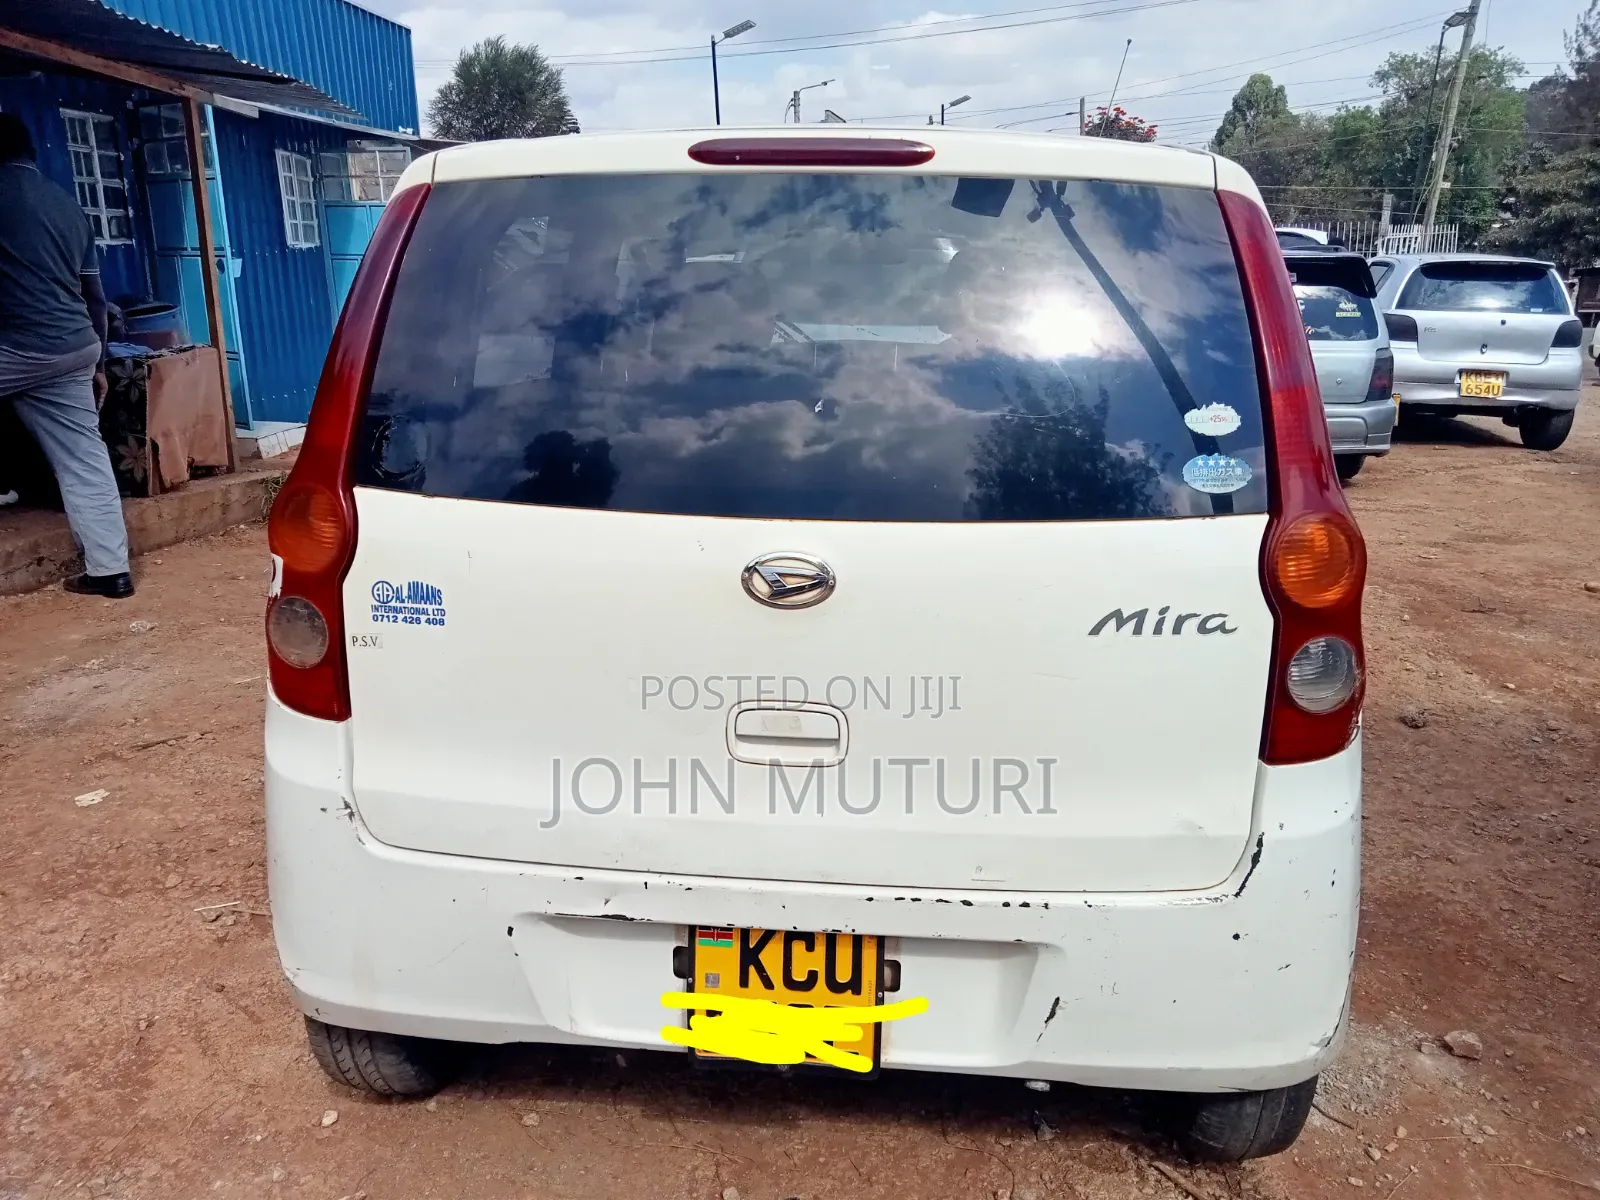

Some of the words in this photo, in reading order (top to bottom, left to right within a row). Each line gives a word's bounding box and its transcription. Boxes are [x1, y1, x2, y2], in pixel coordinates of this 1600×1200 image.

[1465, 384, 1501, 396] 654U
[395, 581, 443, 606] AL-AMAANS
[371, 604, 430, 616] INTERNATIONAL
[432, 608, 446, 617] LTD
[372, 614, 398, 623] 0712
[401, 616, 421, 625] 426
[425, 618, 445, 626] 408
[1087, 605, 1239, 636] Mira
[739, 928, 863, 996] KCU
